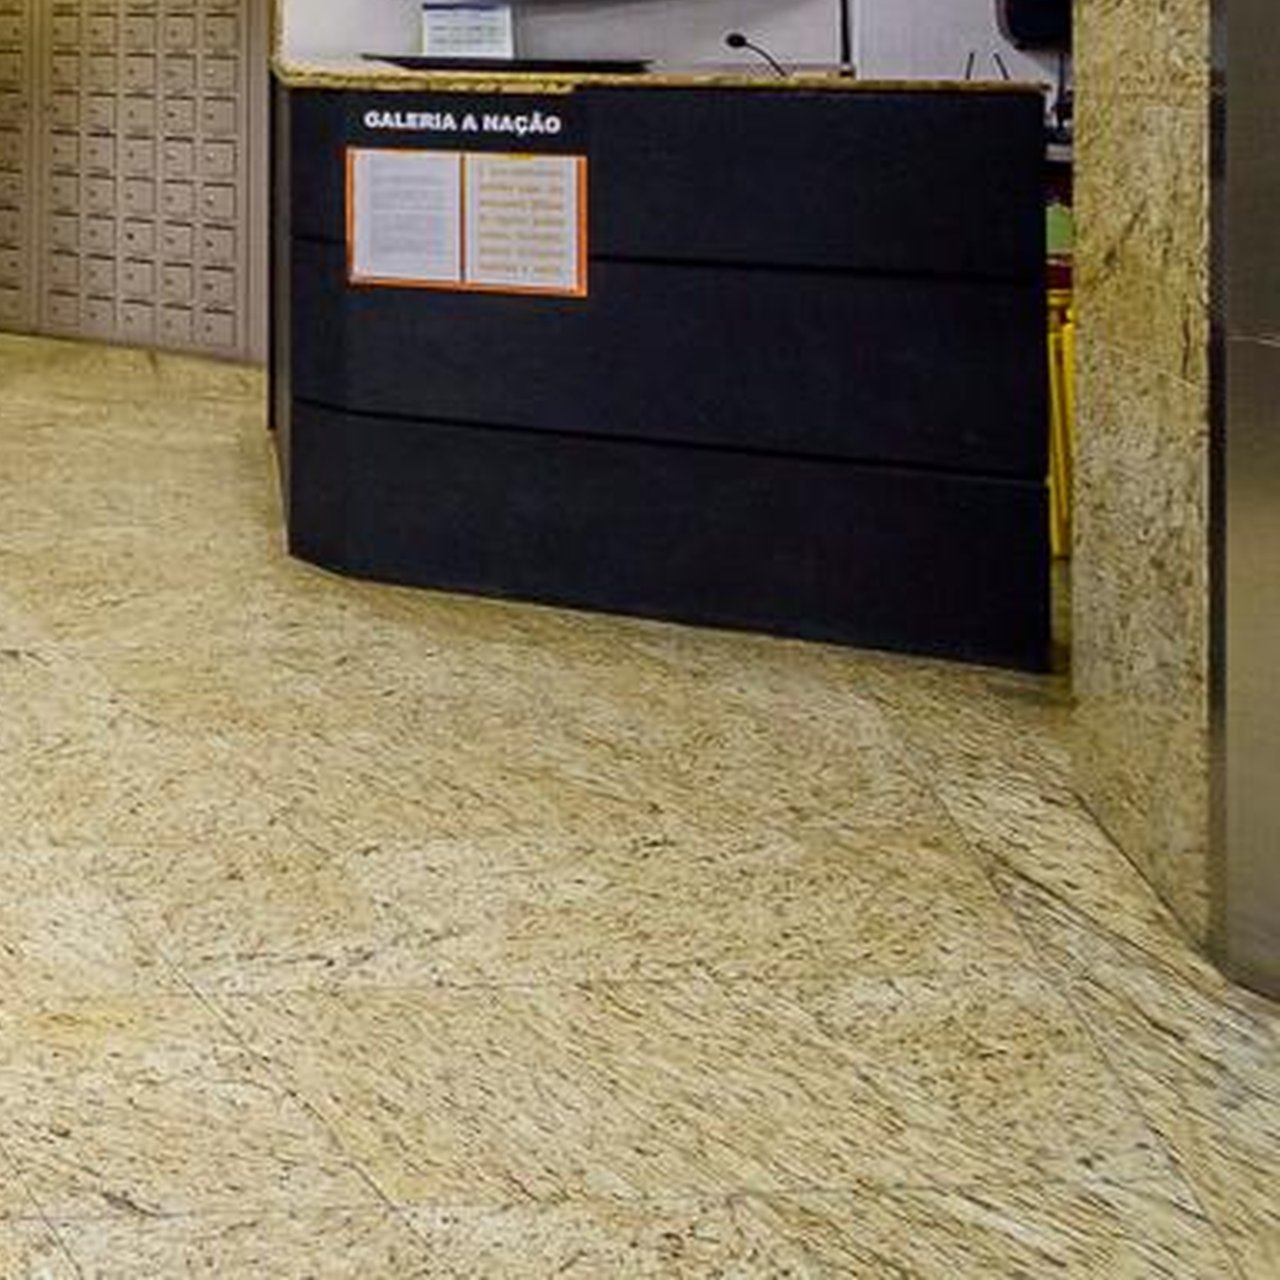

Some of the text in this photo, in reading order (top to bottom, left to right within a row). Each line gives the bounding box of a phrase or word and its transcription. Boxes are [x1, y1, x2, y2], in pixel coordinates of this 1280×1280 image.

[363, 110, 562, 137] GALERIA A NAÇÃO
